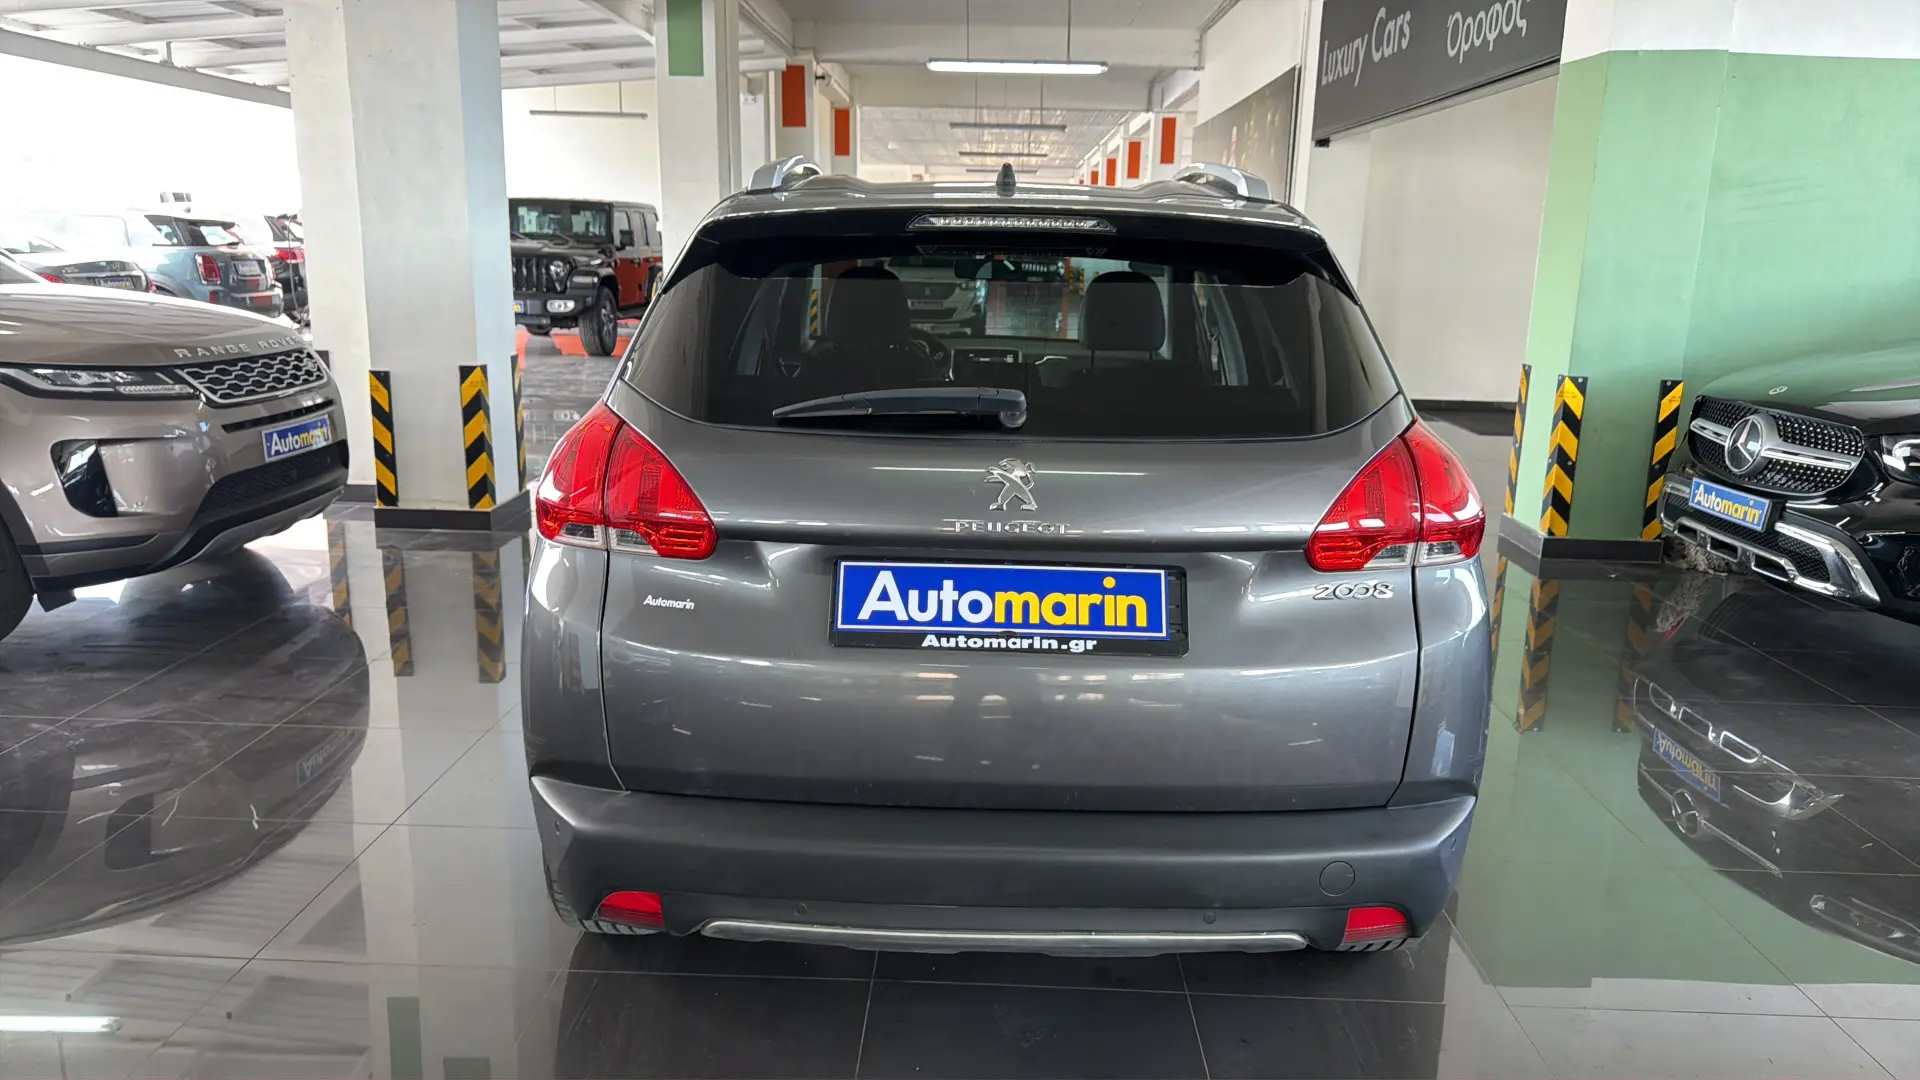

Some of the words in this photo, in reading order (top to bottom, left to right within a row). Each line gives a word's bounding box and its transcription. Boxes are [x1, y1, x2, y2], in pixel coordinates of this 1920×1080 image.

[1321, 34, 1368, 87] Luxury
[1371, 7, 1412, 63] Cars
[173, 343, 251, 358] RANGE
[1694, 484, 1761, 523] Automarin
[954, 521, 1070, 534] PEUGEOT
[857, 570, 1147, 627] Automarin
[1313, 582, 1394, 600] 2008
[642, 594, 695, 610] Automarin
[921, 634, 1098, 653] Automarin.gr
